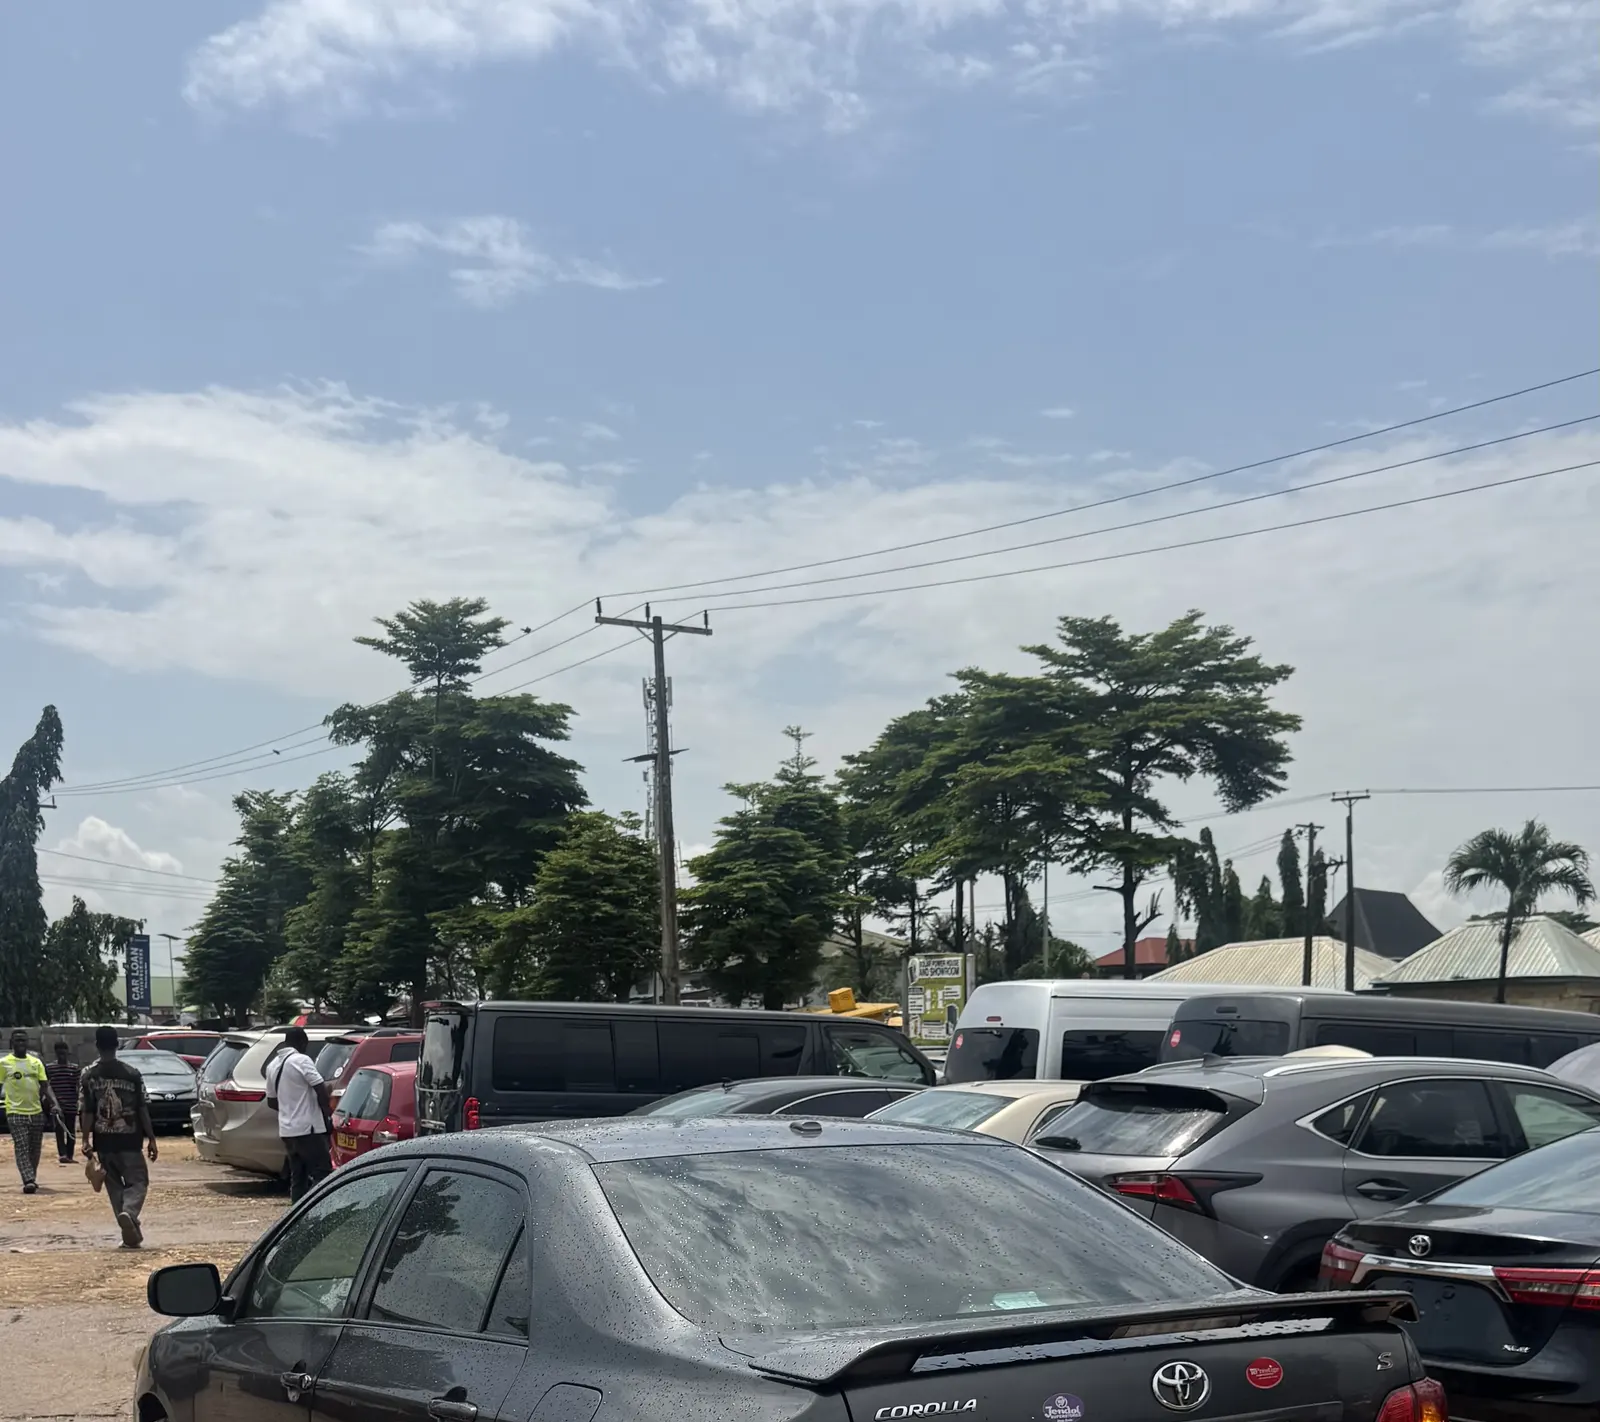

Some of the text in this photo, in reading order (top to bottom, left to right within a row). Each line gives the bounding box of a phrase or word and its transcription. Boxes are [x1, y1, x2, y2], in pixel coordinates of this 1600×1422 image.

[130, 947, 140, 1000] CAR LOAN
[919, 967, 960, 976] AND SHOWROOM
[1376, 1351, 1394, 1371] S
[874, 1399, 977, 1422] COROLLA
[1044, 1404, 1082, 1418] Jendol
